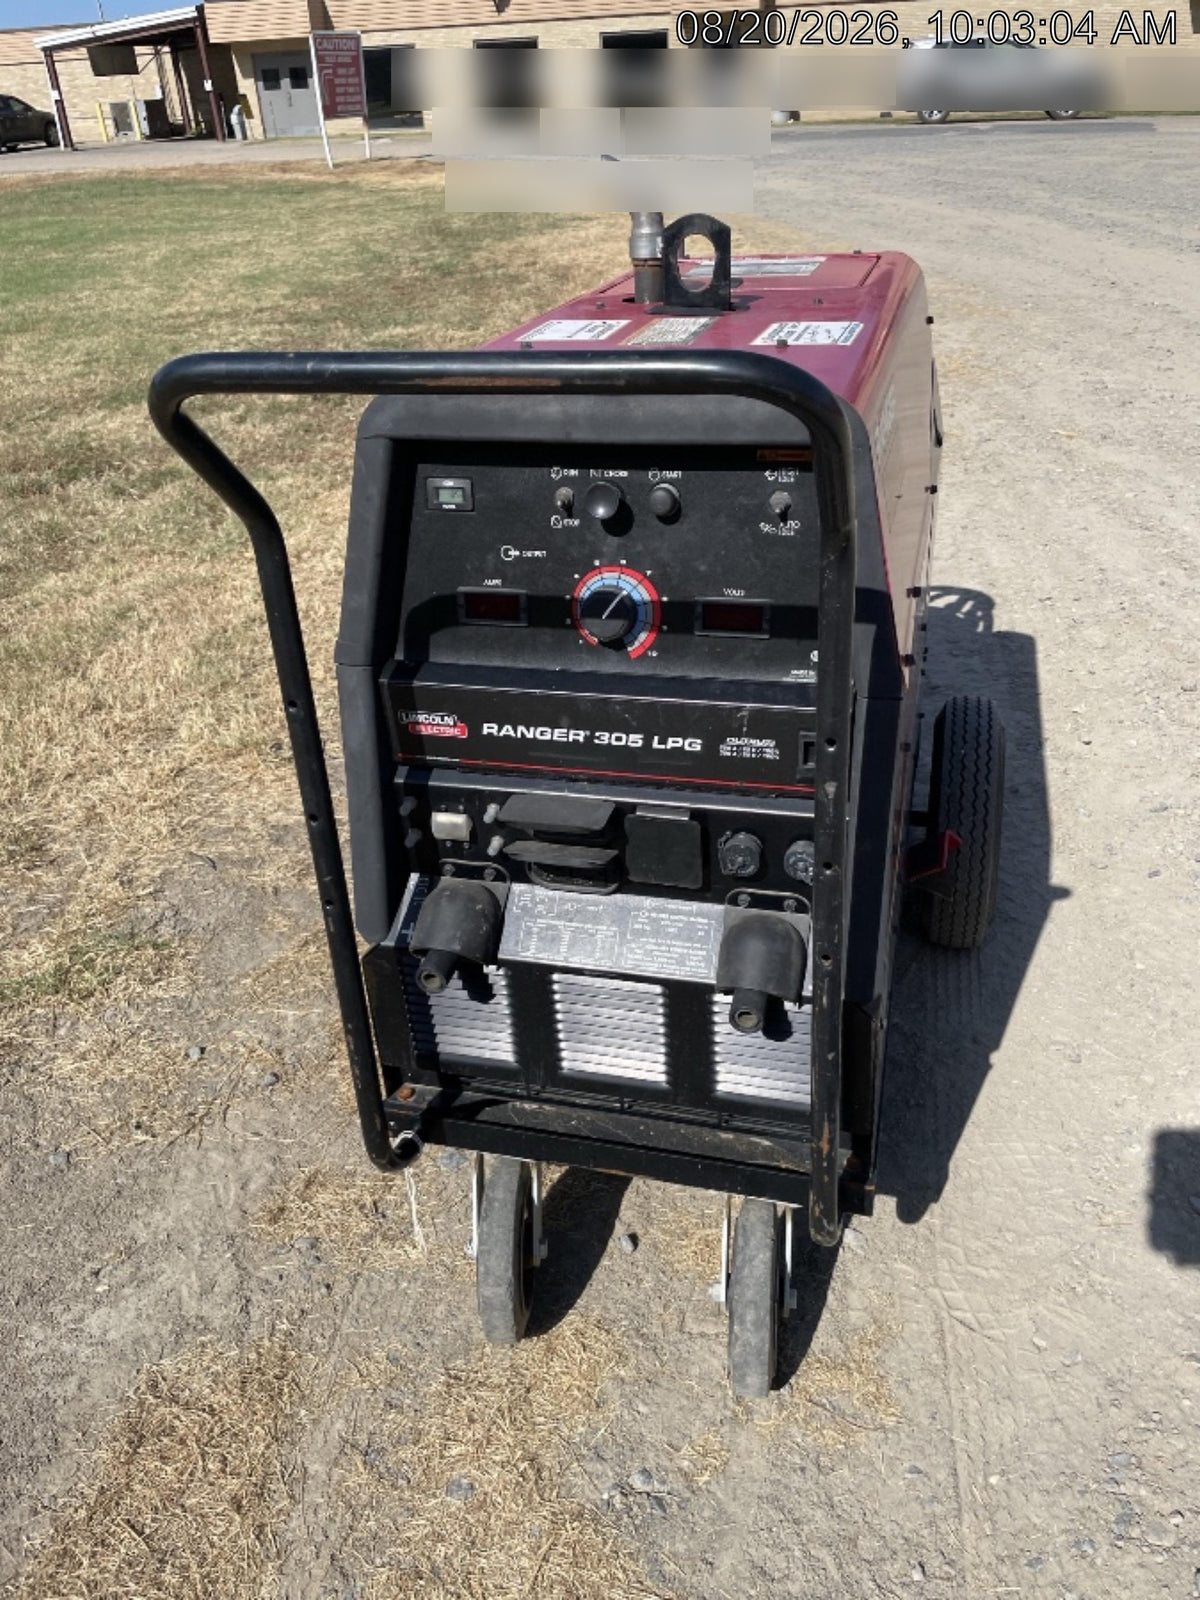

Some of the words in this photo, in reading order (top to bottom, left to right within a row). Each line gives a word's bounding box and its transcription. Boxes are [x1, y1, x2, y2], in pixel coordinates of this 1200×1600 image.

[401, 711, 456, 725] LINCOLN
[482, 722, 587, 743] RANGER
[593, 731, 645, 748] 305
[652, 735, 704, 752] LPG
